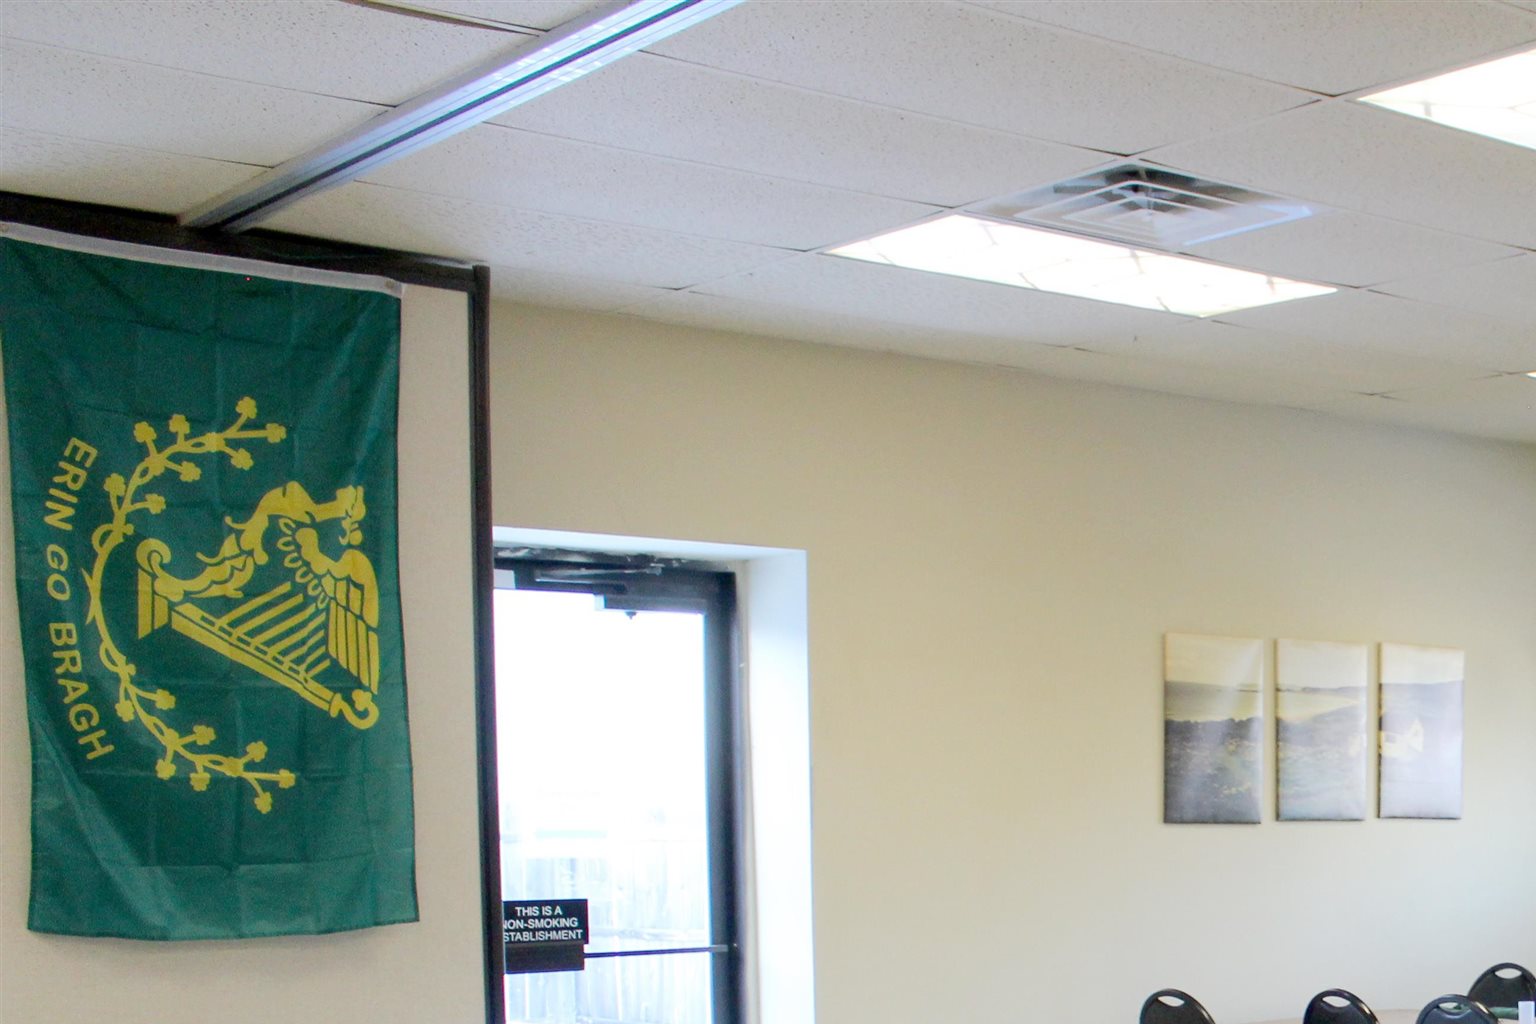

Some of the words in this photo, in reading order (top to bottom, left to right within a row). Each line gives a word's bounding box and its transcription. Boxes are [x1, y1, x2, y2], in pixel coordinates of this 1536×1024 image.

[43, 437, 98, 531] ERIN
[46, 544, 71, 601] GO
[49, 622, 115, 760] BRAGH
[503, 929, 583, 942] STABLISHMENT
[515, 906, 539, 917] THIS
[542, 906, 552, 916] IS
[554, 906, 563, 915] A
